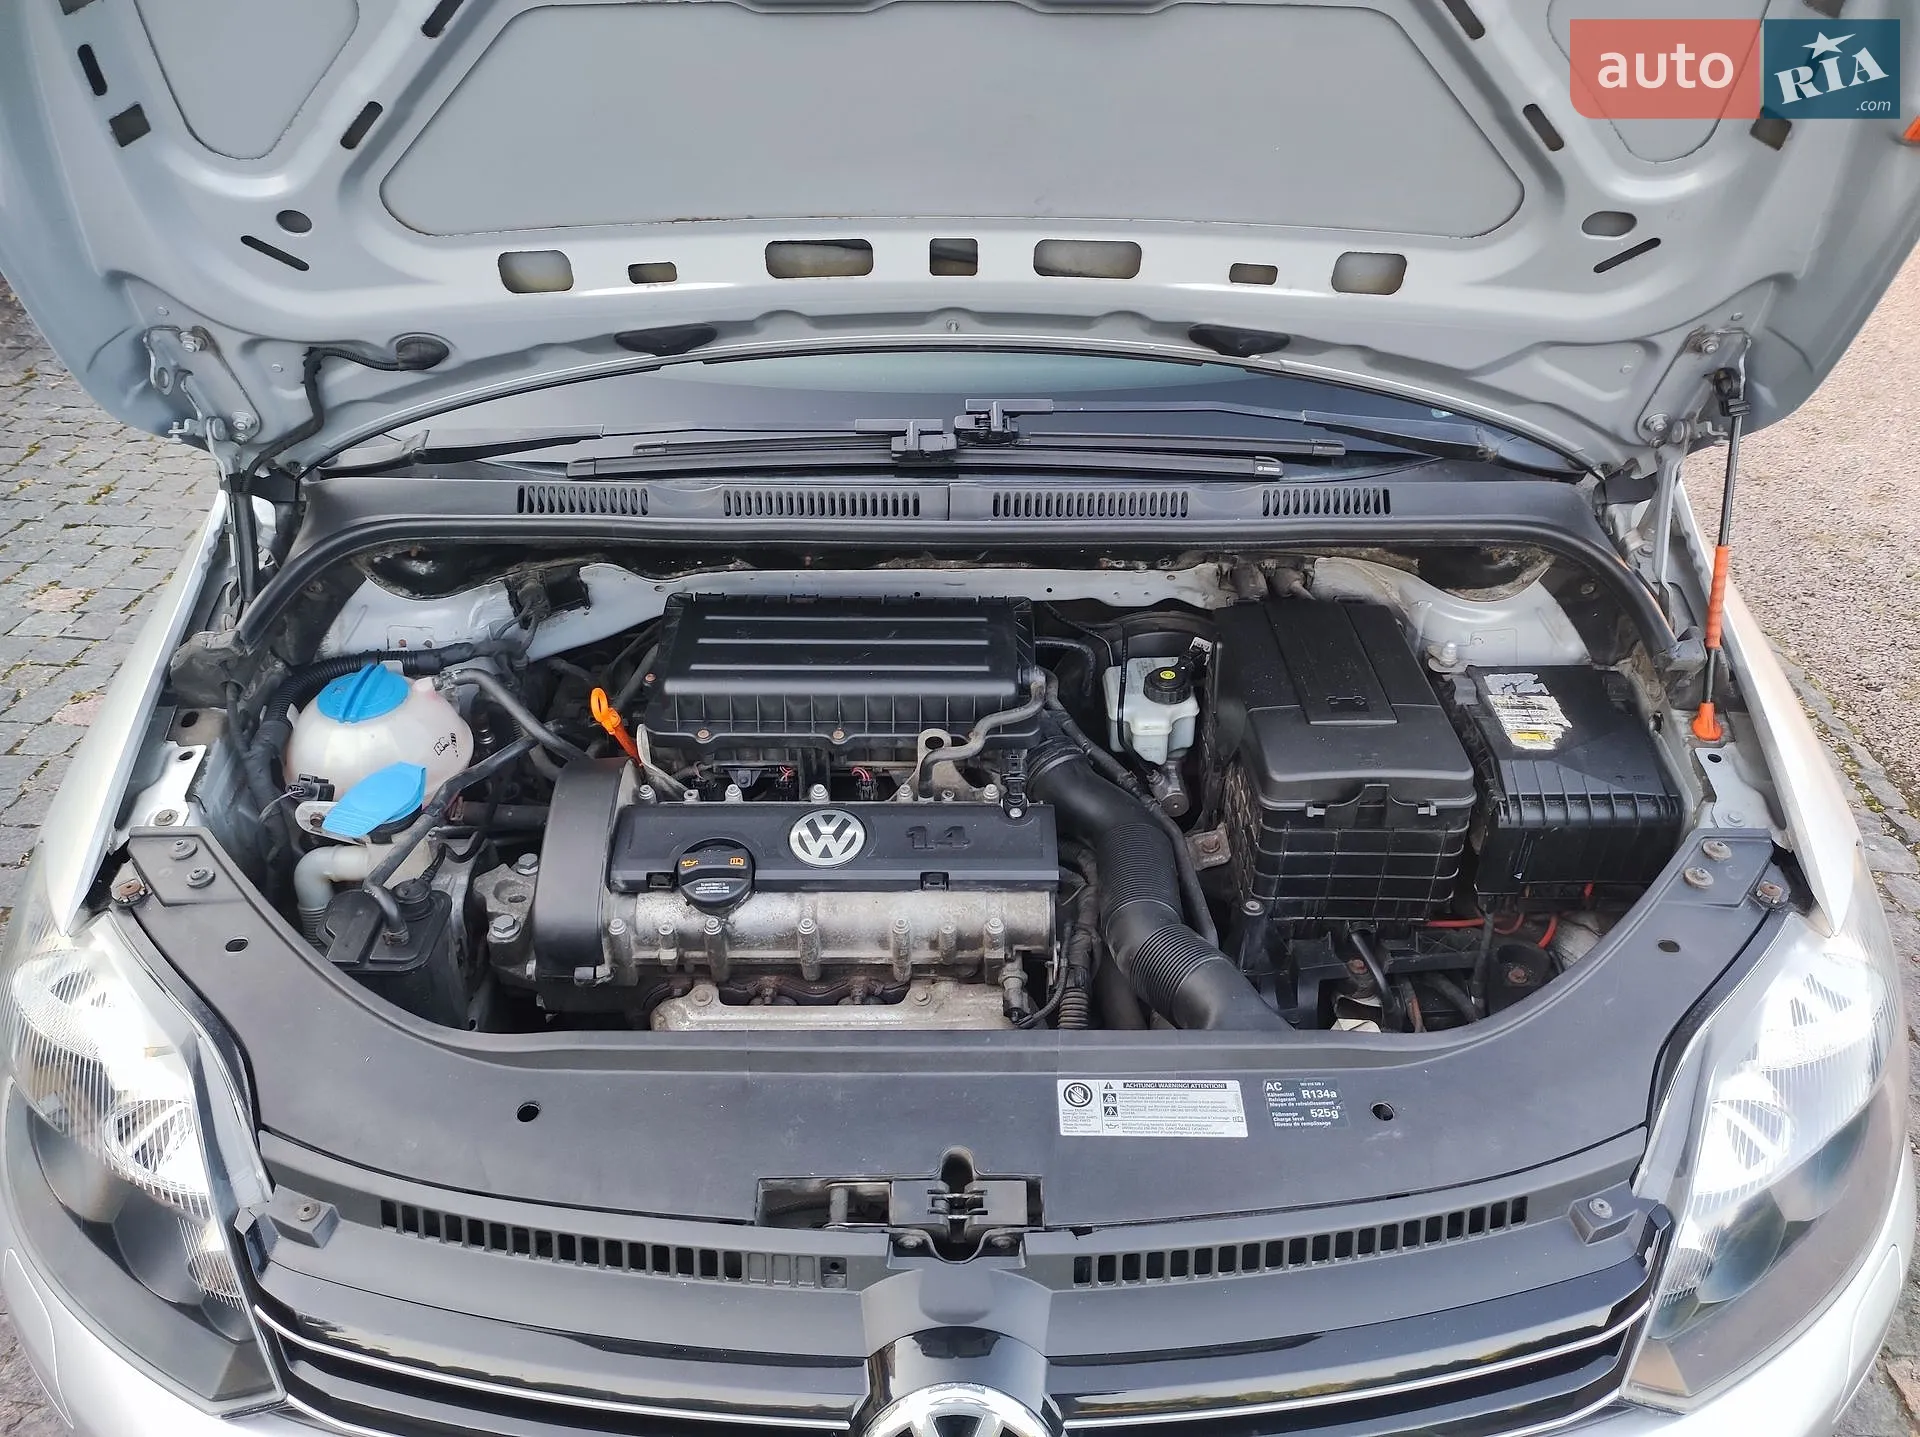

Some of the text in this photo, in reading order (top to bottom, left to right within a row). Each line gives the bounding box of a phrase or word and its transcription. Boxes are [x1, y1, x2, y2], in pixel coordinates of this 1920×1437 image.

[1266, 1082, 1283, 1091] AC
[1301, 1089, 1337, 1099] R134a
[1310, 1108, 1339, 1119] 525g
